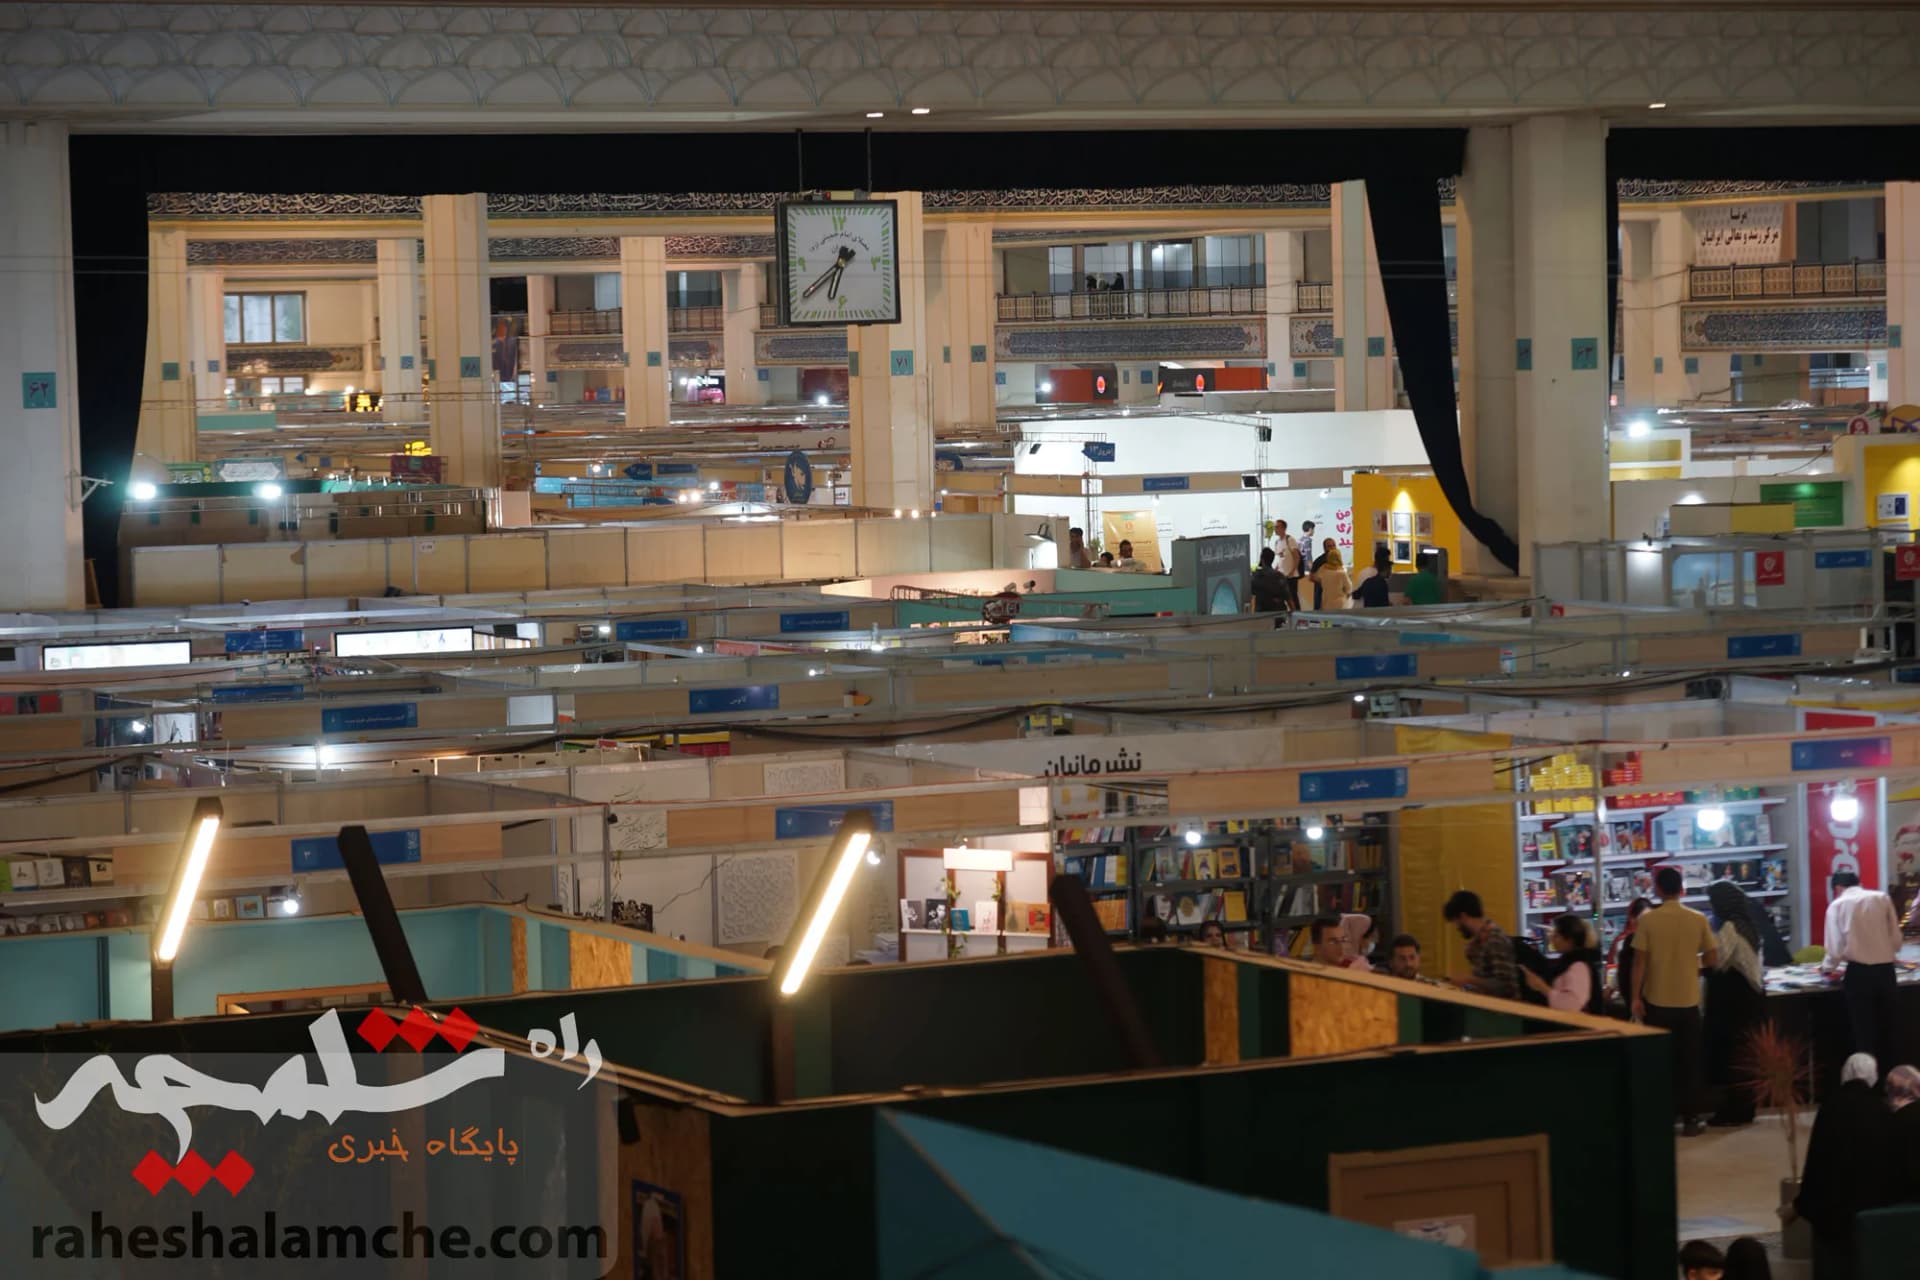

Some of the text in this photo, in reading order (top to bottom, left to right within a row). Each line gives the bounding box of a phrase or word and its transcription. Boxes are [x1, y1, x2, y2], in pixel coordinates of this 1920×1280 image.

[832, 216, 846, 231] ۱۲
[1701, 228, 1725, 247] ایرانیان
[1763, 227, 1779, 245] مرکز
[798, 256, 806, 272] ۹
[1044, 747, 1141, 777] نشر مانیان
